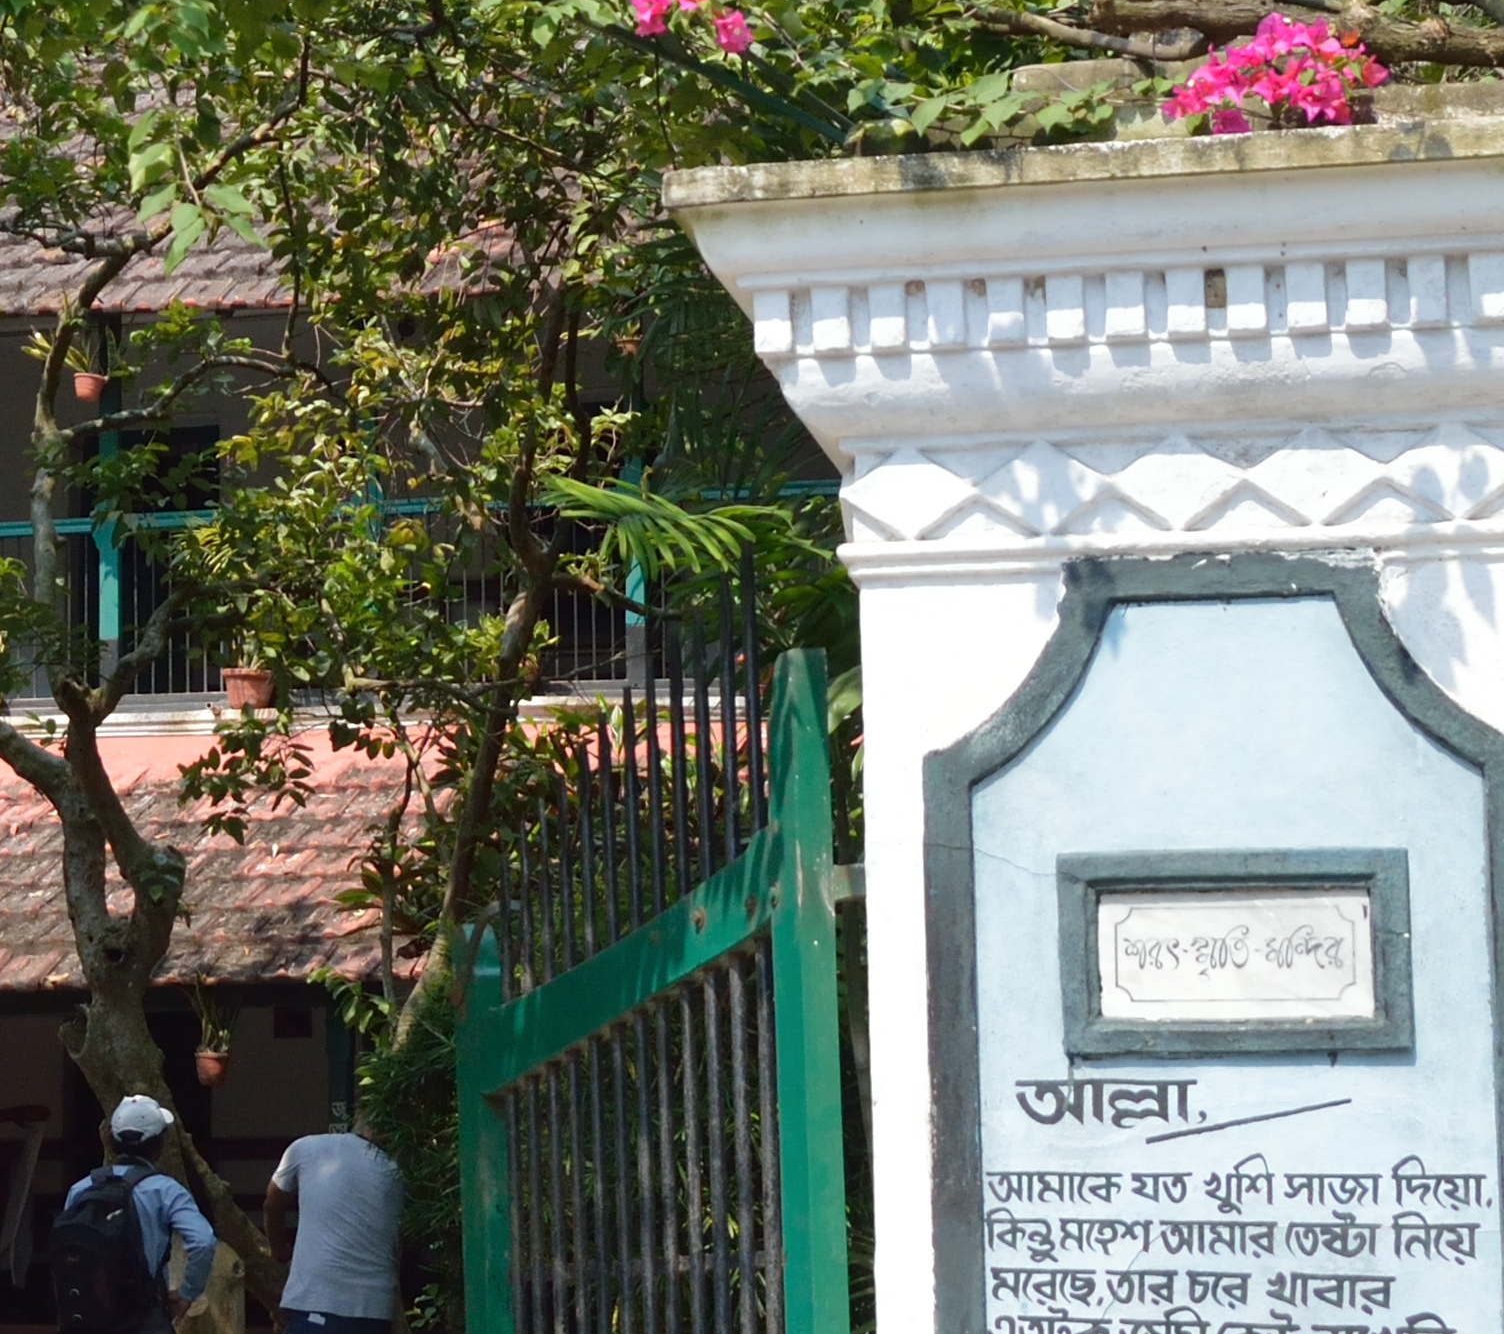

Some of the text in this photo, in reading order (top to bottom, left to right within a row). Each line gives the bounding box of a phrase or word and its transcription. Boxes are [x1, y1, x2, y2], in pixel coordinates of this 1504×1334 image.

[985, 1170, 1124, 1205] আমাকে
[1130, 1171, 1194, 1204] যত
[1202, 1152, 1276, 1216] খুশি
[1283, 1172, 1384, 1206] সাজা
[984, 1206, 1482, 1266] কিন্তু মহেশ আমার তেষ্টা নিয়ে
[1184, 1269, 1253, 1311] চরে
[1265, 1271, 1397, 1317] খাবার
